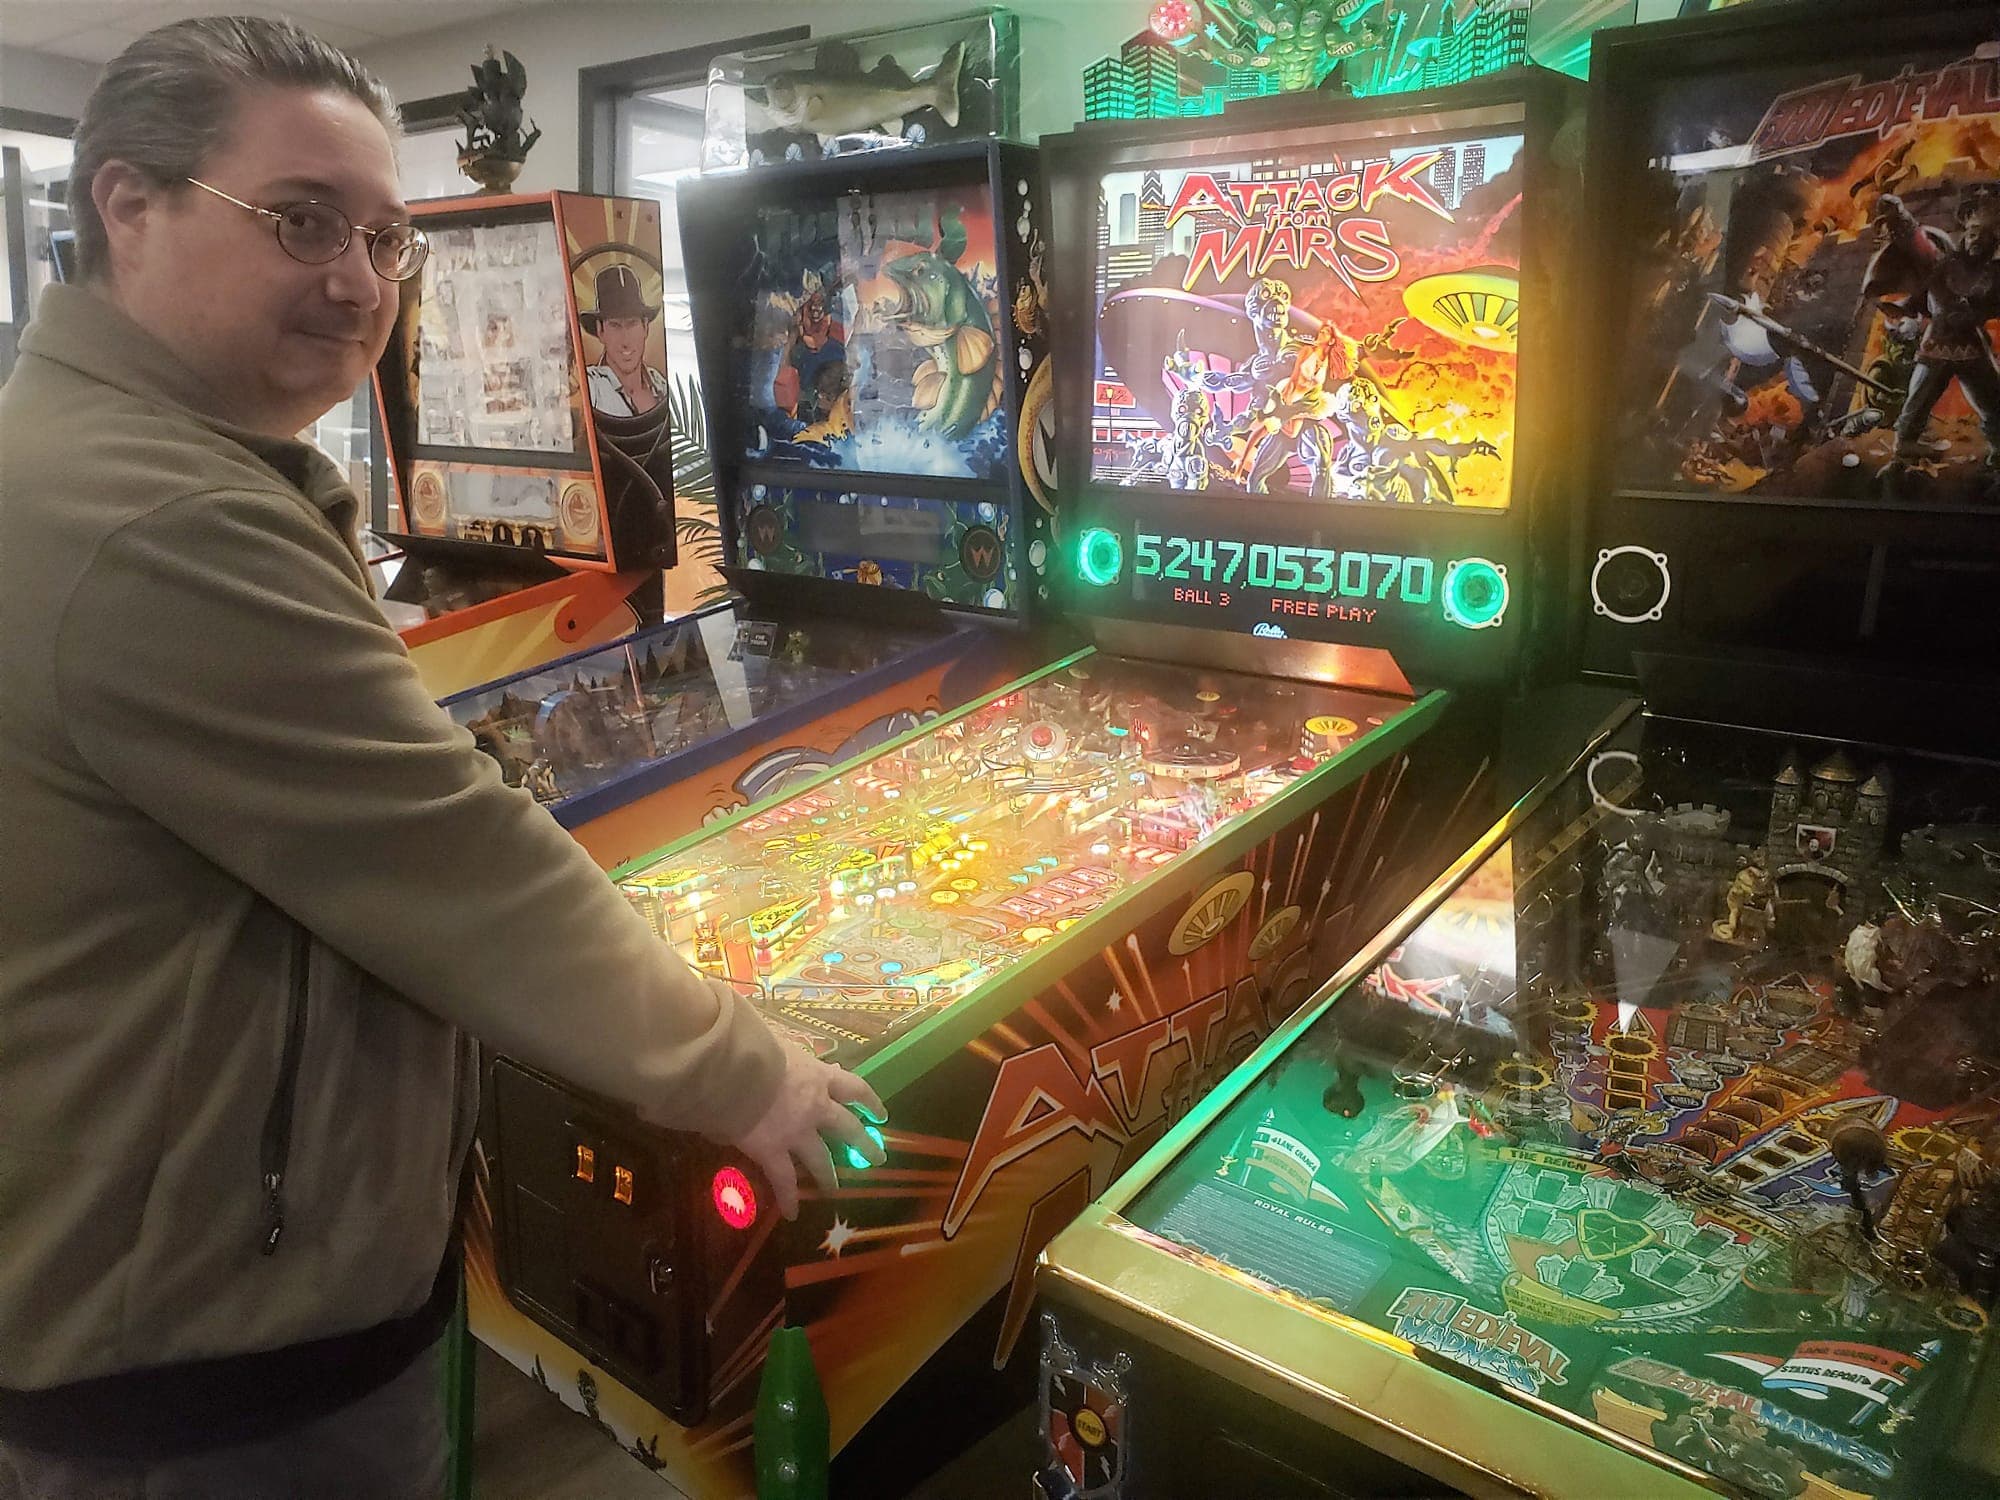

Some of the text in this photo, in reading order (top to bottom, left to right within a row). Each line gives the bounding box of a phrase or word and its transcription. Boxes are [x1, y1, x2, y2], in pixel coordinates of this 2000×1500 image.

[1164, 151, 1455, 230] ATTACK
[1264, 207, 1331, 232] from
[1182, 217, 1402, 298] MARS
[1135, 534, 1434, 604] 5,247,053,070
[1173, 587, 1231, 607] BALL 3
[1270, 598, 1377, 623] FREE PLAY
[1510, 1149, 1588, 1172] THE REIGN
[1253, 1198, 1335, 1236] ROYAL RULES
[1713, 1207, 1737, 1219] OF
[1400, 1291, 1569, 1386] MEDIEVAL
[1780, 1365, 1865, 1384] STATUS REPORT
[1077, 1418, 1103, 1438] START
